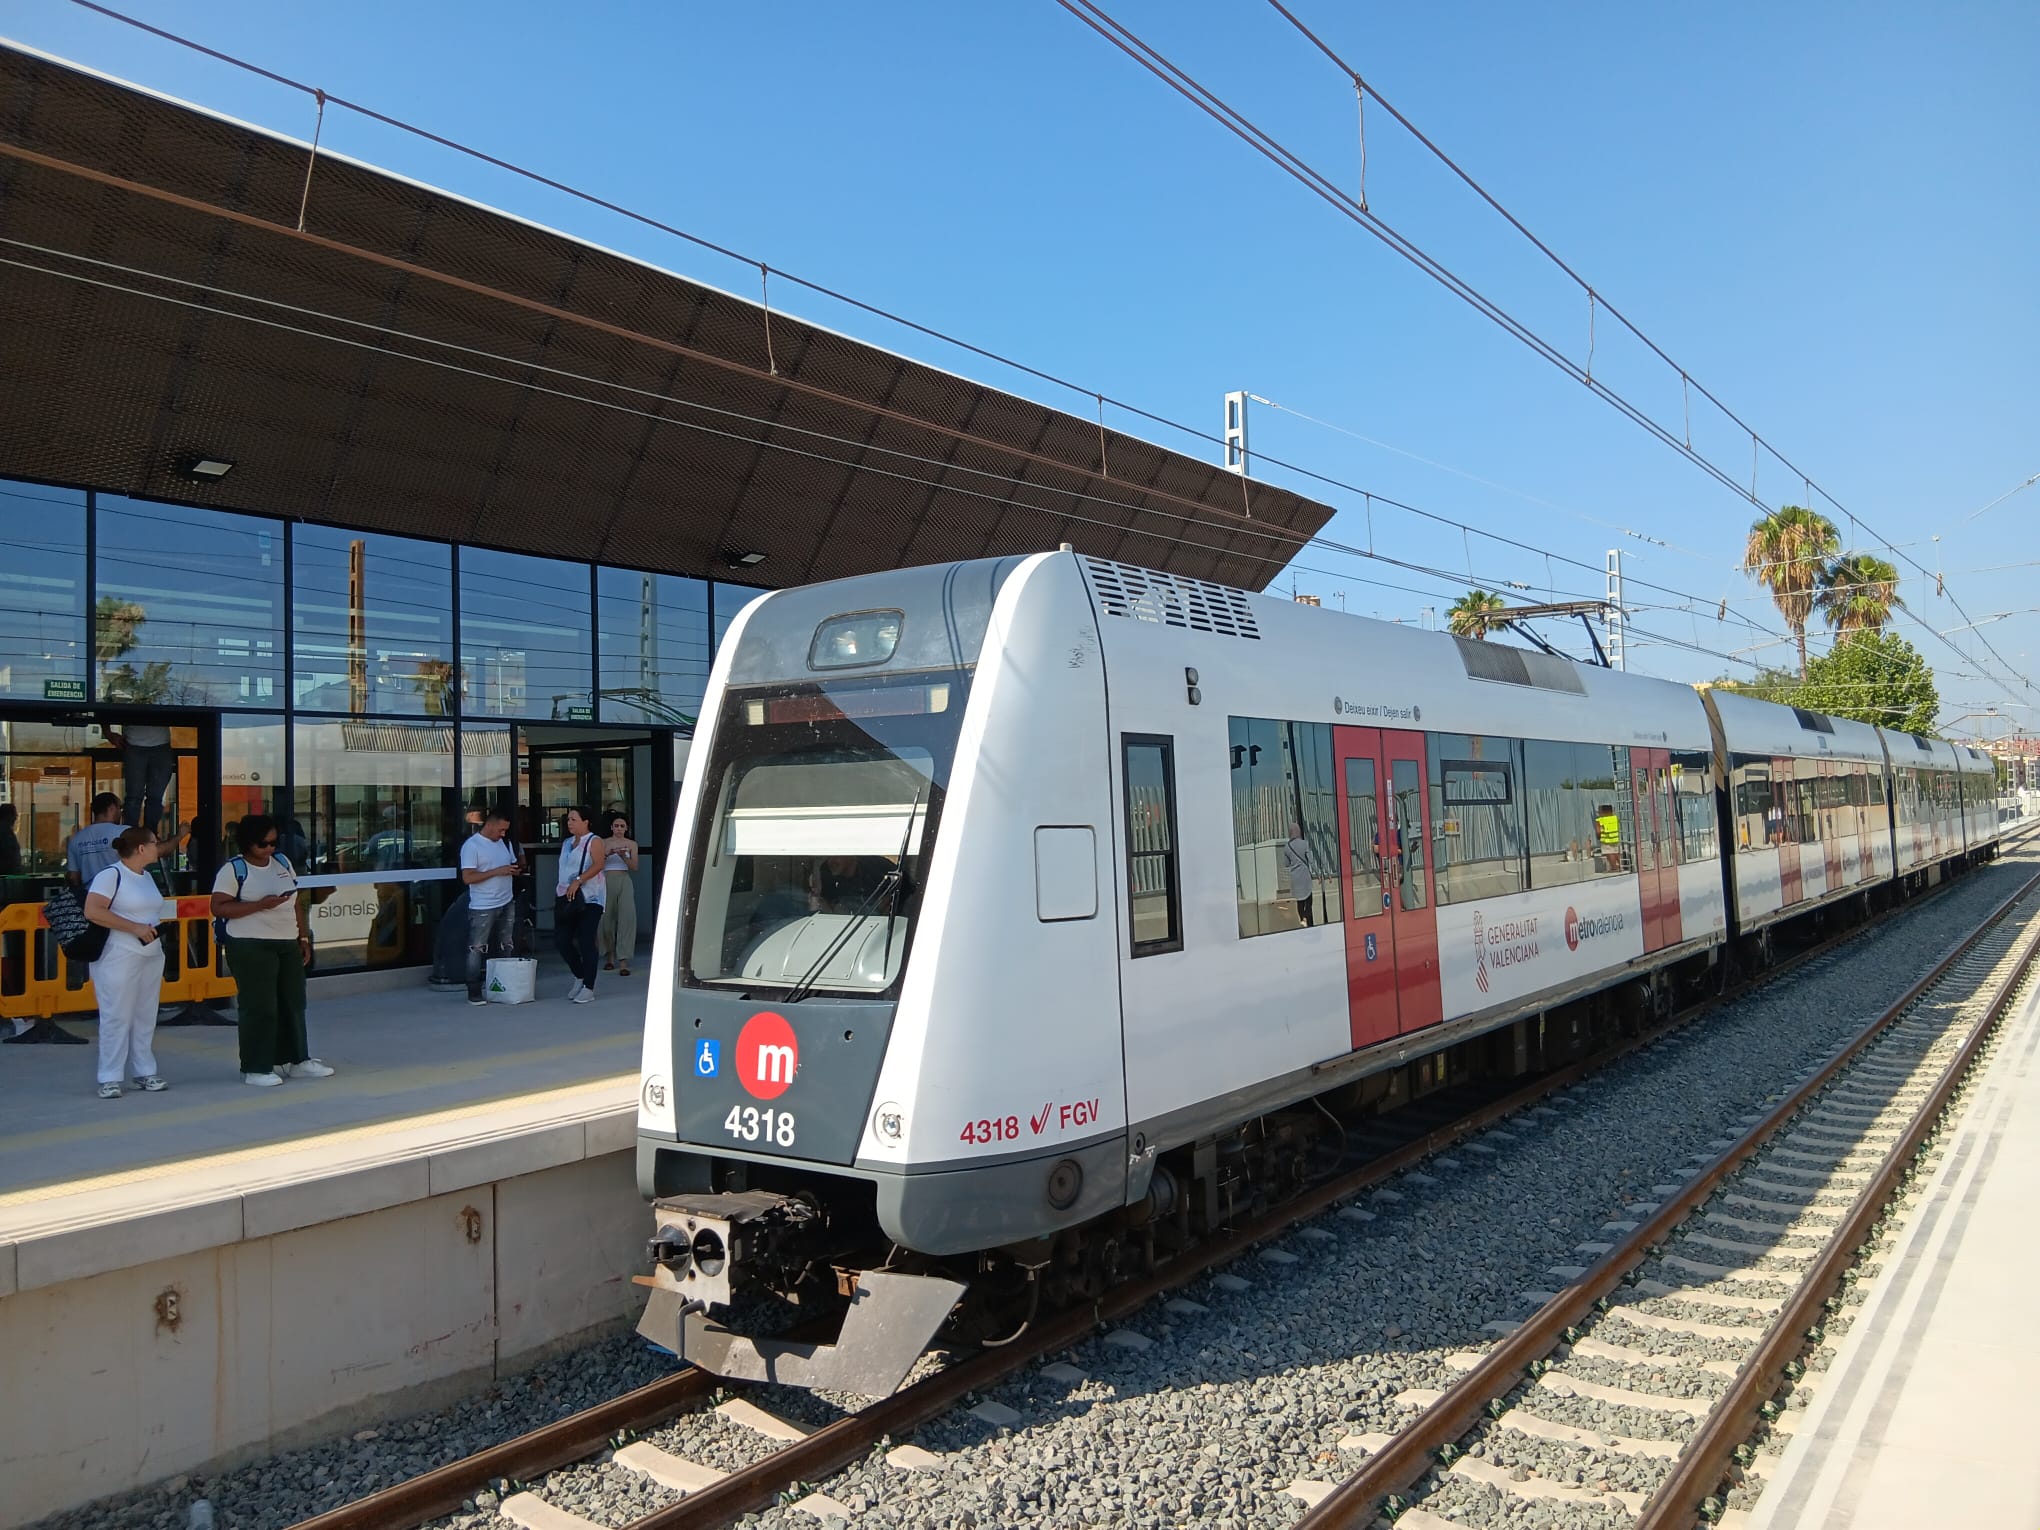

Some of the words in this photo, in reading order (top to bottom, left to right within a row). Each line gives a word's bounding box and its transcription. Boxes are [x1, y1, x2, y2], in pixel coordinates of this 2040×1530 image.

[50, 681, 71, 689] SALIDA
[72, 682, 81, 690] DE
[1344, 701, 1365, 715] Deixeu
[1383, 705, 1399, 720] Dejen
[1400, 708, 1412, 719] salir
[1487, 917, 1539, 945] GENERALITAT
[1569, 912, 1625, 943] metrovalencia
[1489, 941, 1540, 969] VALENCIANA
[757, 1044, 795, 1084] m
[724, 1105, 795, 1147] 4318
[960, 1115, 1020, 1145] 4318
[1060, 1098, 1099, 1129] FGV
